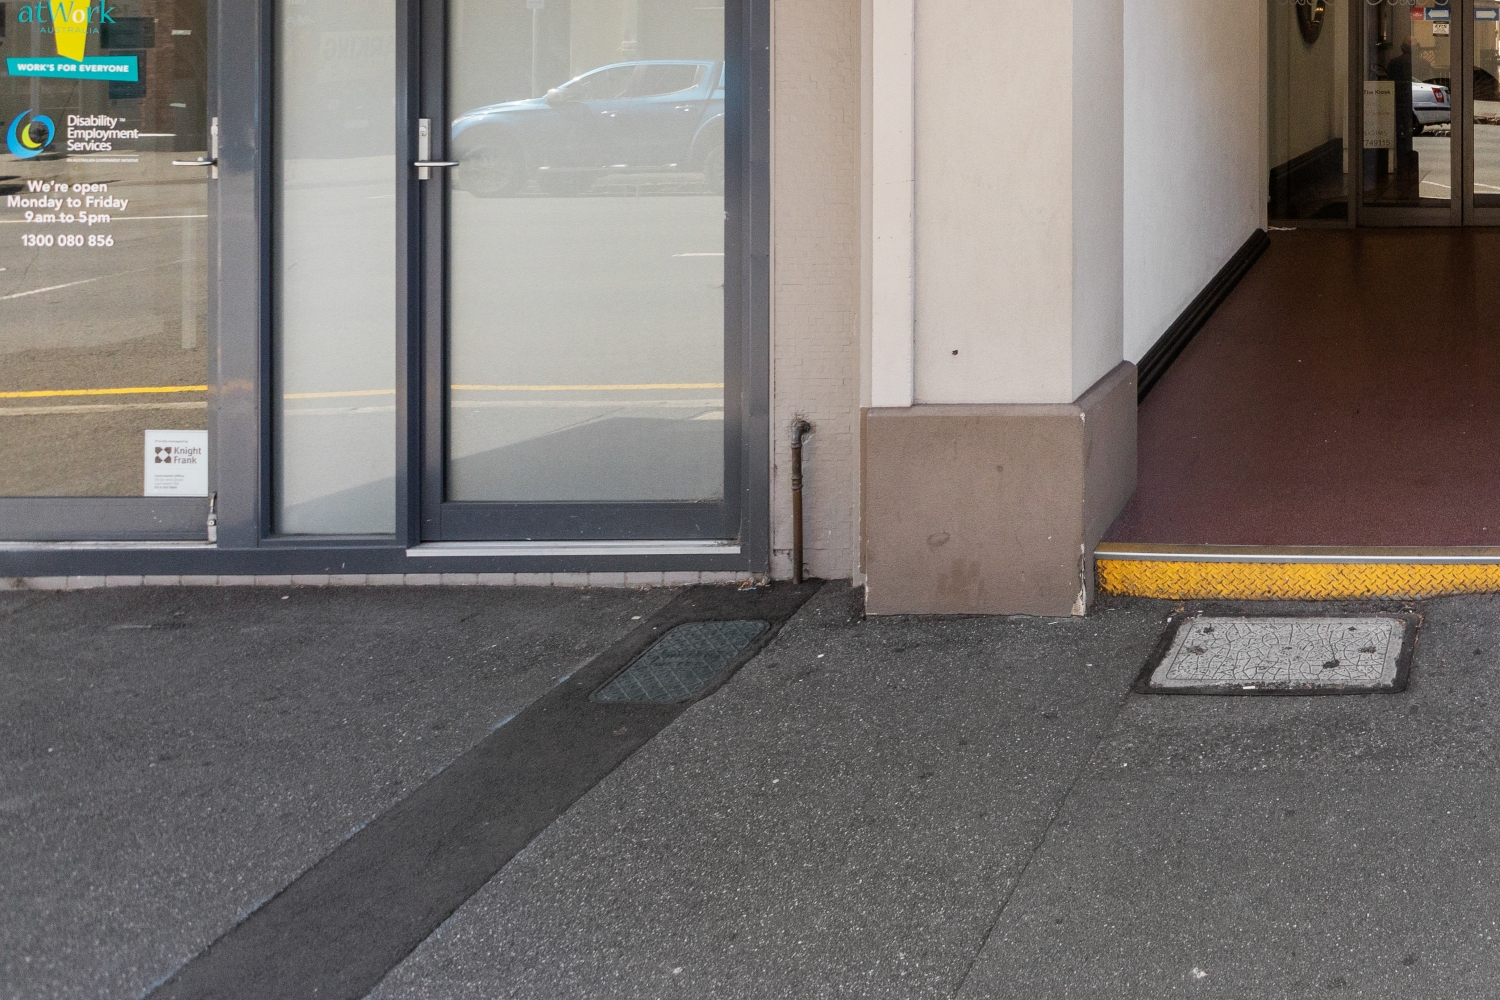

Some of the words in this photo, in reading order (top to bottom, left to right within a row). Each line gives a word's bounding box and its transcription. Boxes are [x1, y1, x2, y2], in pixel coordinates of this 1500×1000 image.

[17, 0, 116, 24] atWork
[39, 26, 100, 34] AUSTRALIA
[17, 63, 55, 72] WORK'S
[57, 64, 77, 72] FOR
[79, 64, 129, 73] EVERYONE
[67, 114, 118, 129] Disability
[67, 127, 139, 141] Employment
[67, 139, 112, 151] Services
[73, 183, 108, 195] open
[7, 195, 63, 211] Monday
[66, 197, 82, 208] to
[85, 195, 129, 211] Friday
[25, 211, 56, 223] 9am
[59, 212, 75, 223] to
[79, 211, 111, 226] 5pm
[21, 234, 54, 247] 1300
[57, 234, 85, 247] 080
[88, 234, 115, 247] 856
[174, 446, 202, 456] Knight
[174, 456, 197, 464] Frank
